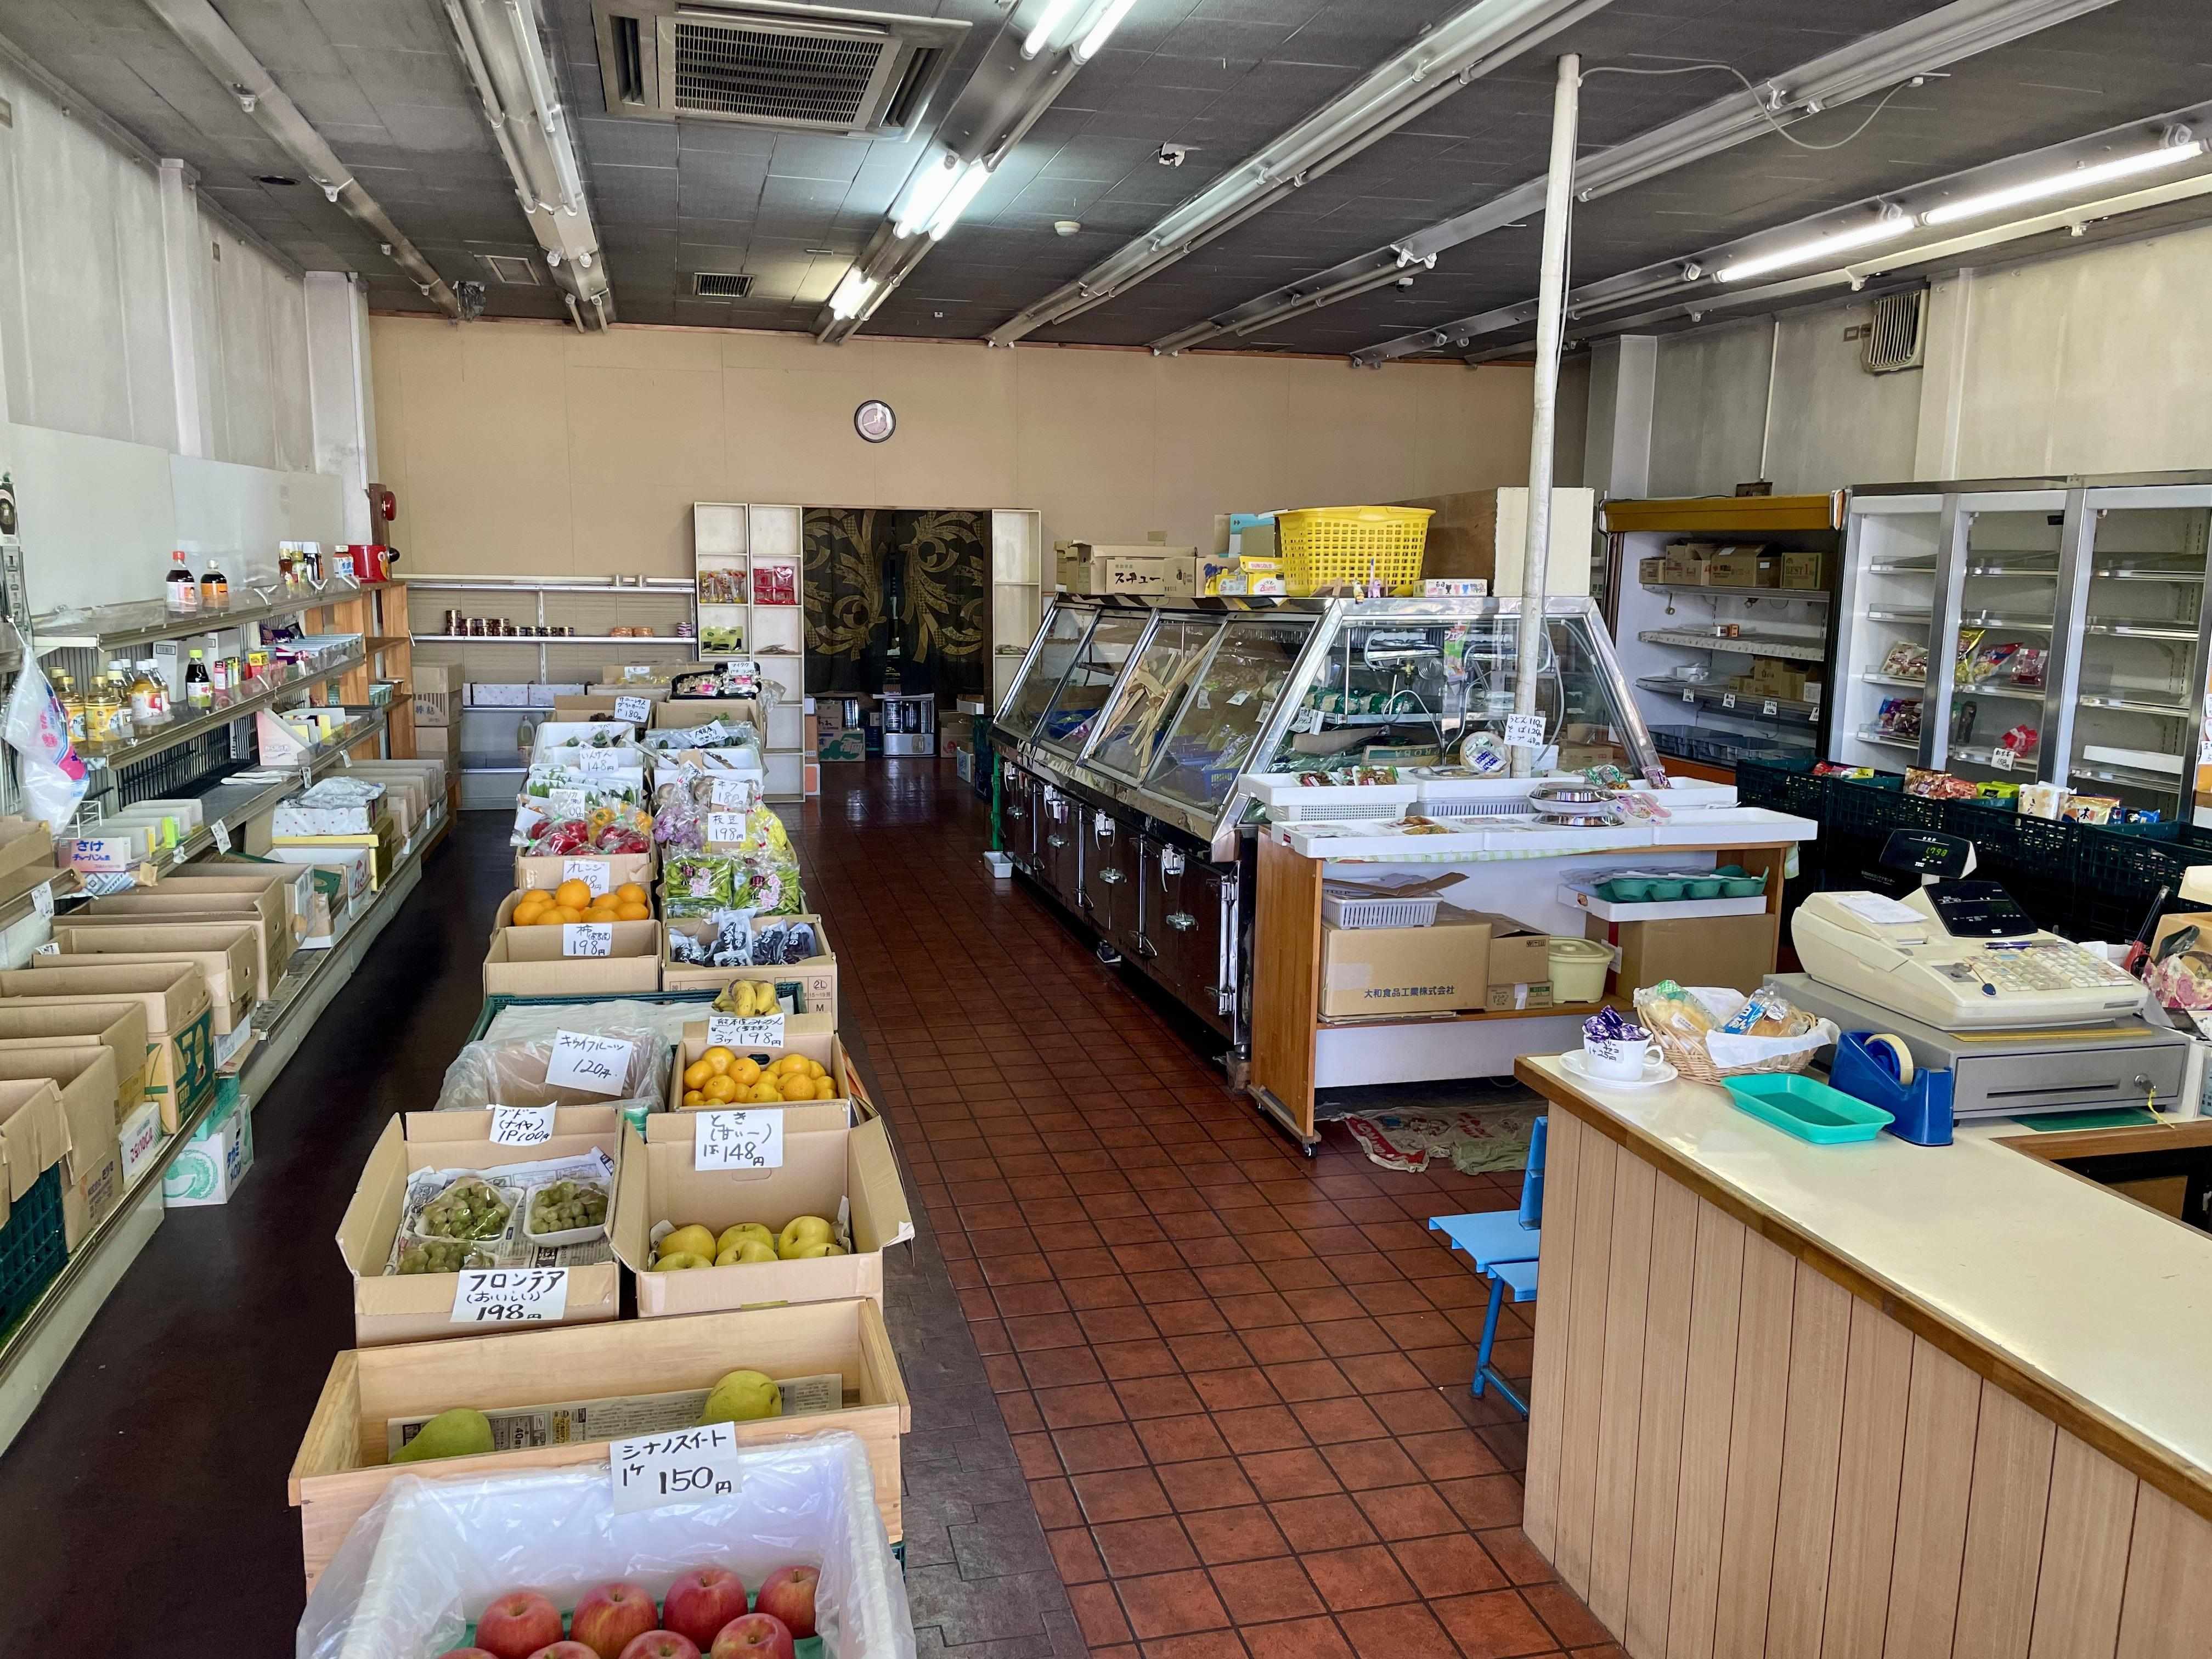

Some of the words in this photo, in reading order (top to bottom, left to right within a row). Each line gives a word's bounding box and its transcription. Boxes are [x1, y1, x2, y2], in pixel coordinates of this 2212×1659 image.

[714, 815, 740, 824] 枝豆
[714, 827, 744, 841] 198円
[76, 840, 104, 851] さけ
[567, 862, 606, 873] オレンジ
[575, 924, 593, 937] 柿
[573, 940, 606, 956] 198円
[814, 980, 827, 990] 2L
[1364, 985, 1455, 998] 大和食品工業株式会社
[740, 1032, 781, 1046] 198円
[572, 1059, 612, 1079] 120円
[498, 1109, 537, 1119] ブドー
[711, 1112, 746, 1127] とき
[724, 1141, 764, 1166] 148円
[470, 1271, 565, 1293] フロンテア
[476, 1304, 542, 1321] 198円
[622, 1429, 727, 1460] シナノスイート
[659, 1466, 732, 1494] 150円
